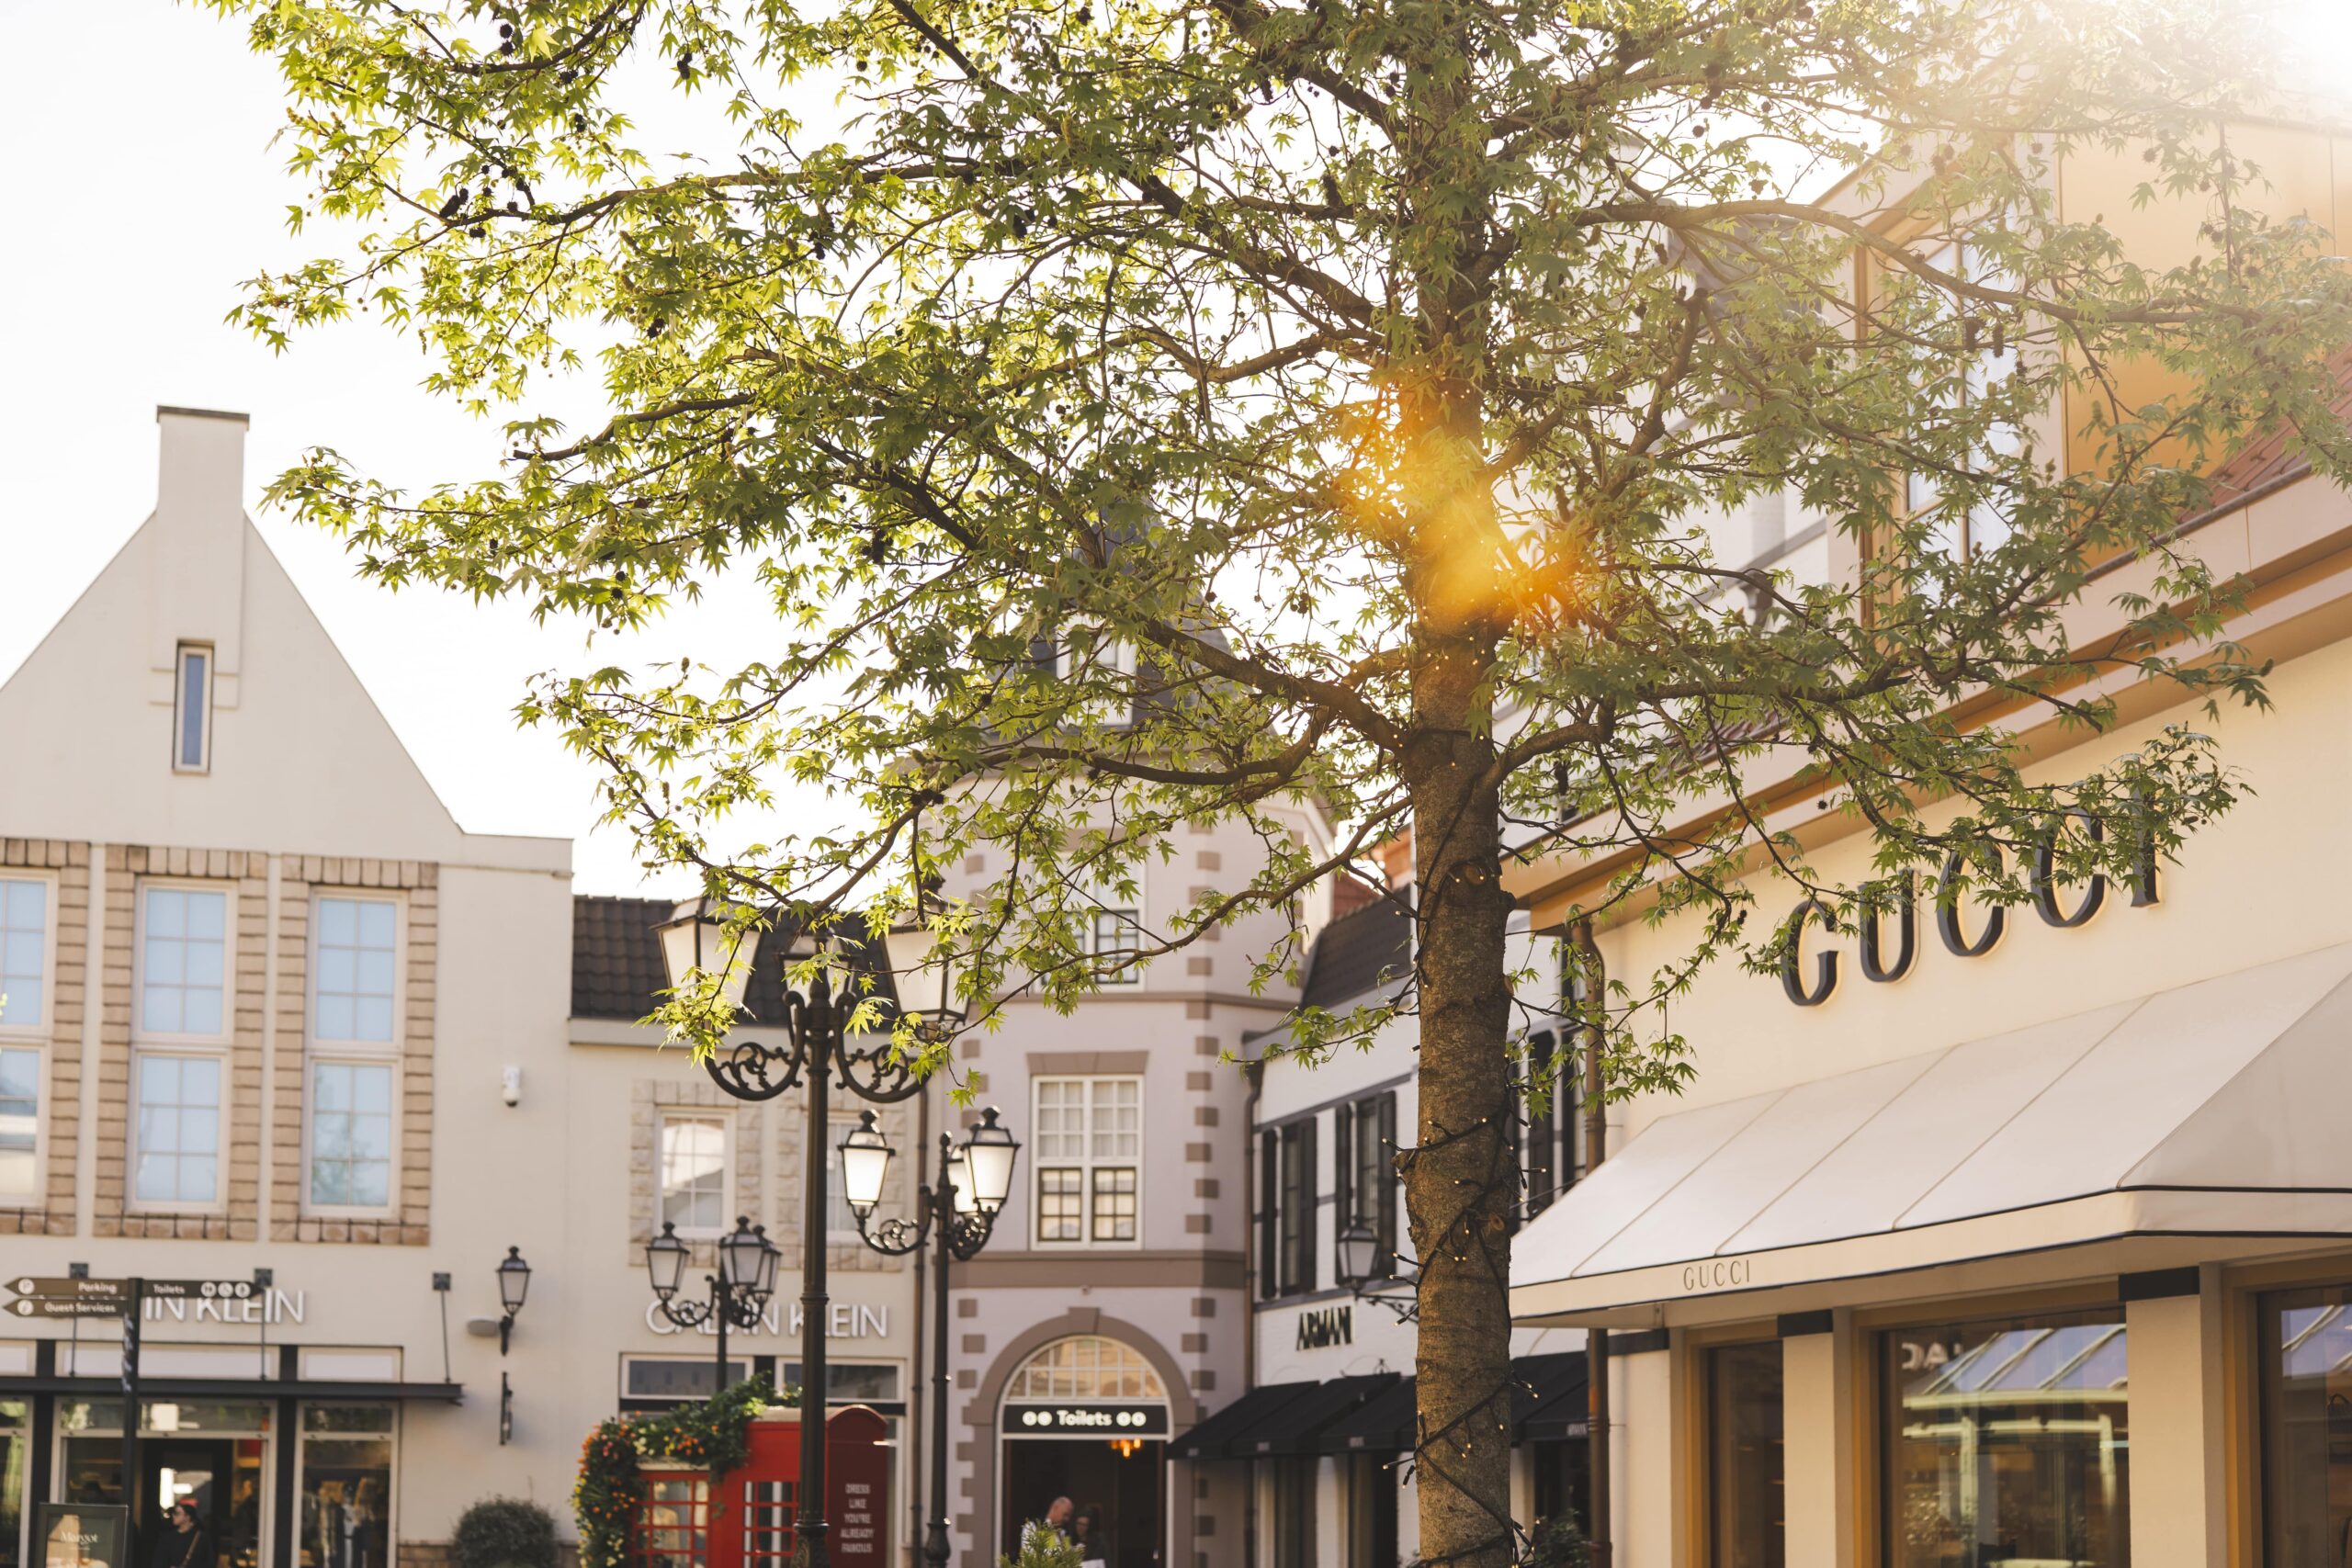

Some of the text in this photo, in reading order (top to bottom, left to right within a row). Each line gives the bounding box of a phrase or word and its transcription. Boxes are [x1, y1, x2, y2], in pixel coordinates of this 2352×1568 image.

[1780, 783, 2162, 1008] GUCCI
[1683, 1258, 1750, 1292] GUCCI
[78, 1282, 118, 1295] Parking
[153, 1283, 186, 1295] Toilets
[75, 1301, 117, 1314] Services
[196, 1289, 304, 1324] KLEIN
[789, 1303, 888, 1337] KEIN
[1056, 1409, 1113, 1427] Toilets
